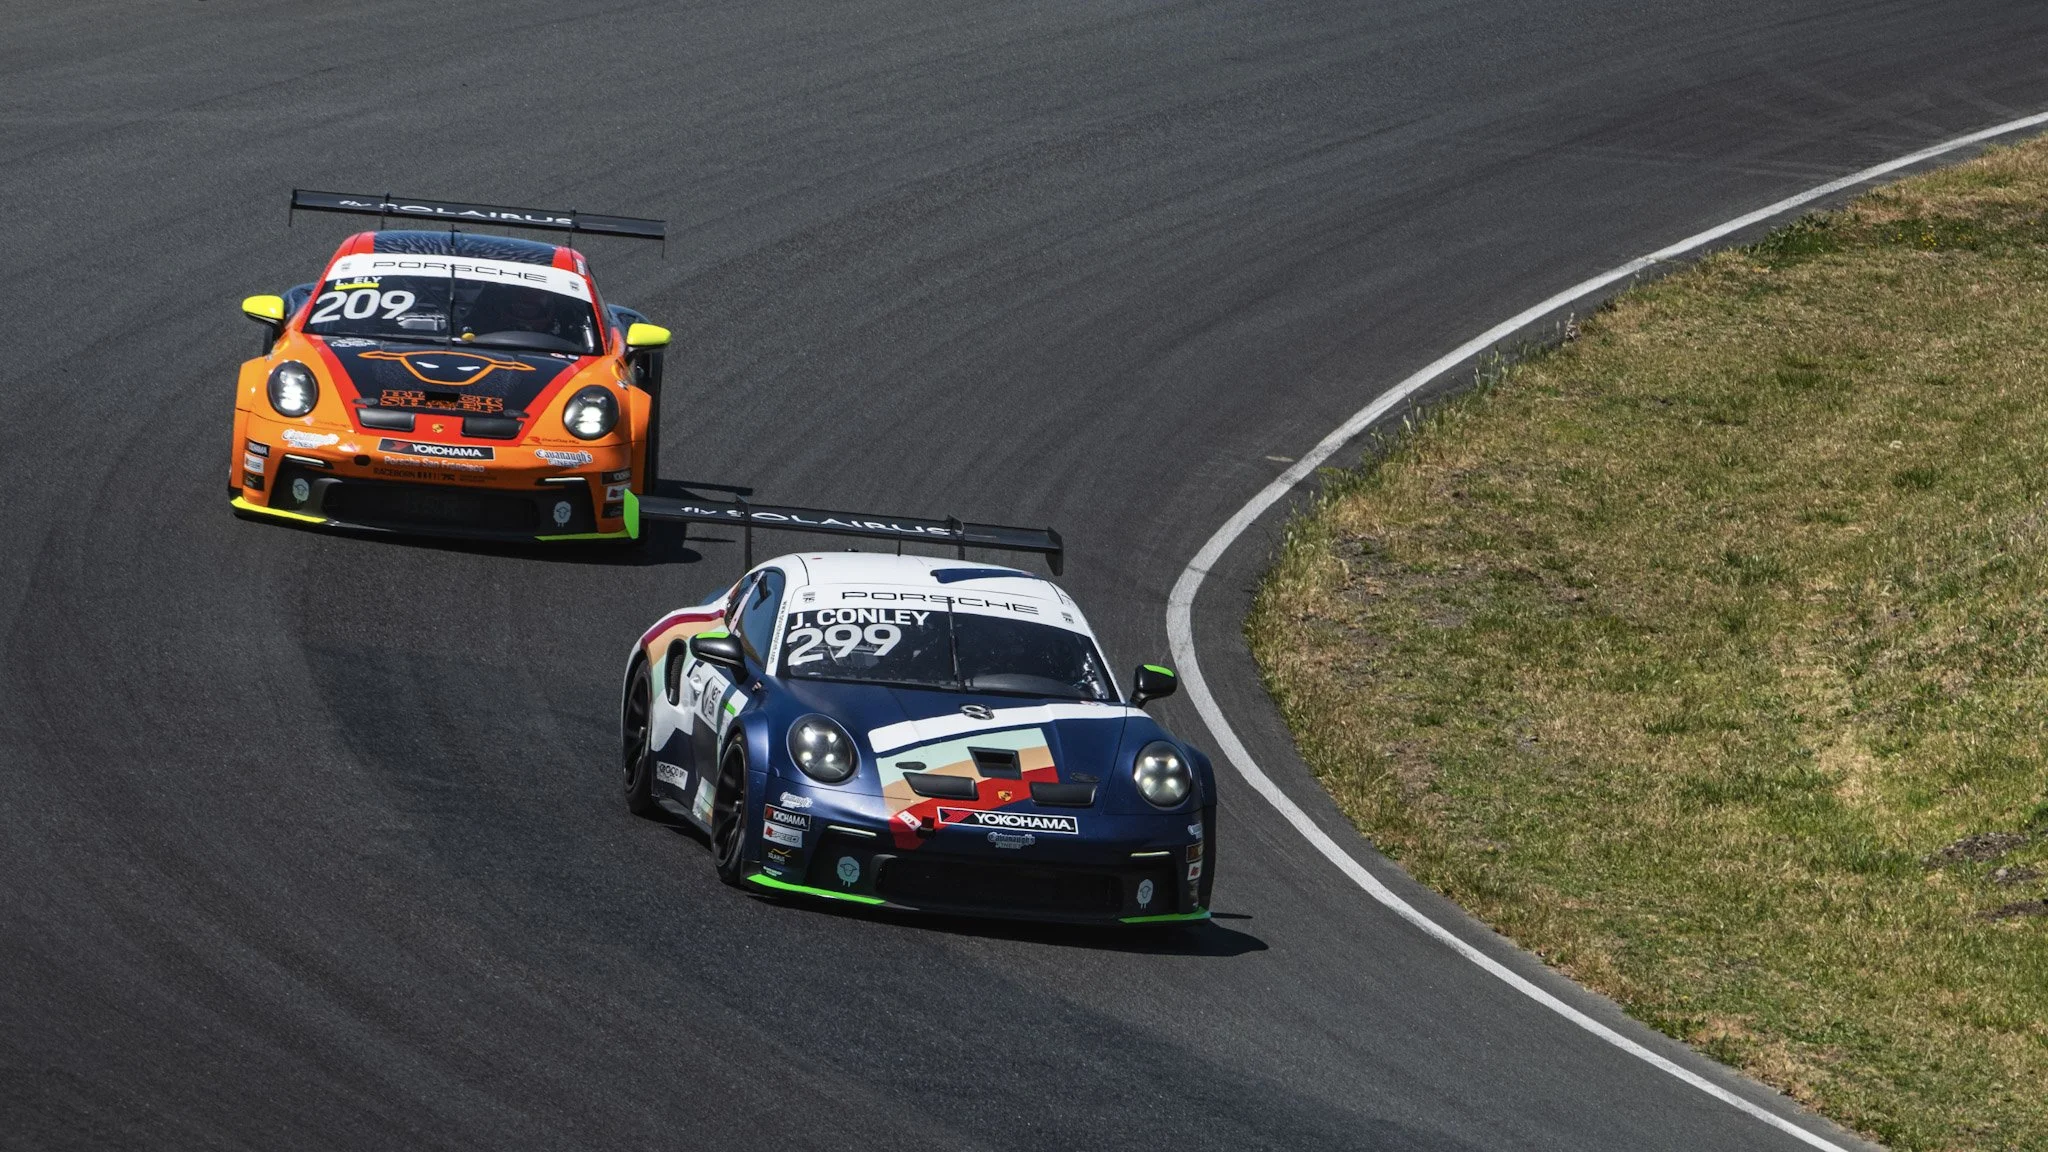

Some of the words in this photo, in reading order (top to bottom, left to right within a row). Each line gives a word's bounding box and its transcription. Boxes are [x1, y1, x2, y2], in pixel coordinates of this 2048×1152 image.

[353, 276, 383, 285] ELY
[373, 261, 548, 283] PORSCHE
[310, 288, 416, 325] 209
[412, 443, 483, 457] YOKOHAMA
[535, 448, 593, 464] Cavanaugh's
[384, 455, 420, 467] Porsche
[422, 457, 440, 468] San
[441, 459, 485, 473] Francisco
[727, 509, 951, 536] SOLAIRUS
[842, 591, 1040, 616] PORSCHE
[790, 612, 812, 631] J.
[816, 608, 931, 626] CONLEY
[786, 623, 902, 668] 299
[973, 812, 1072, 831] YOKOHAMA
